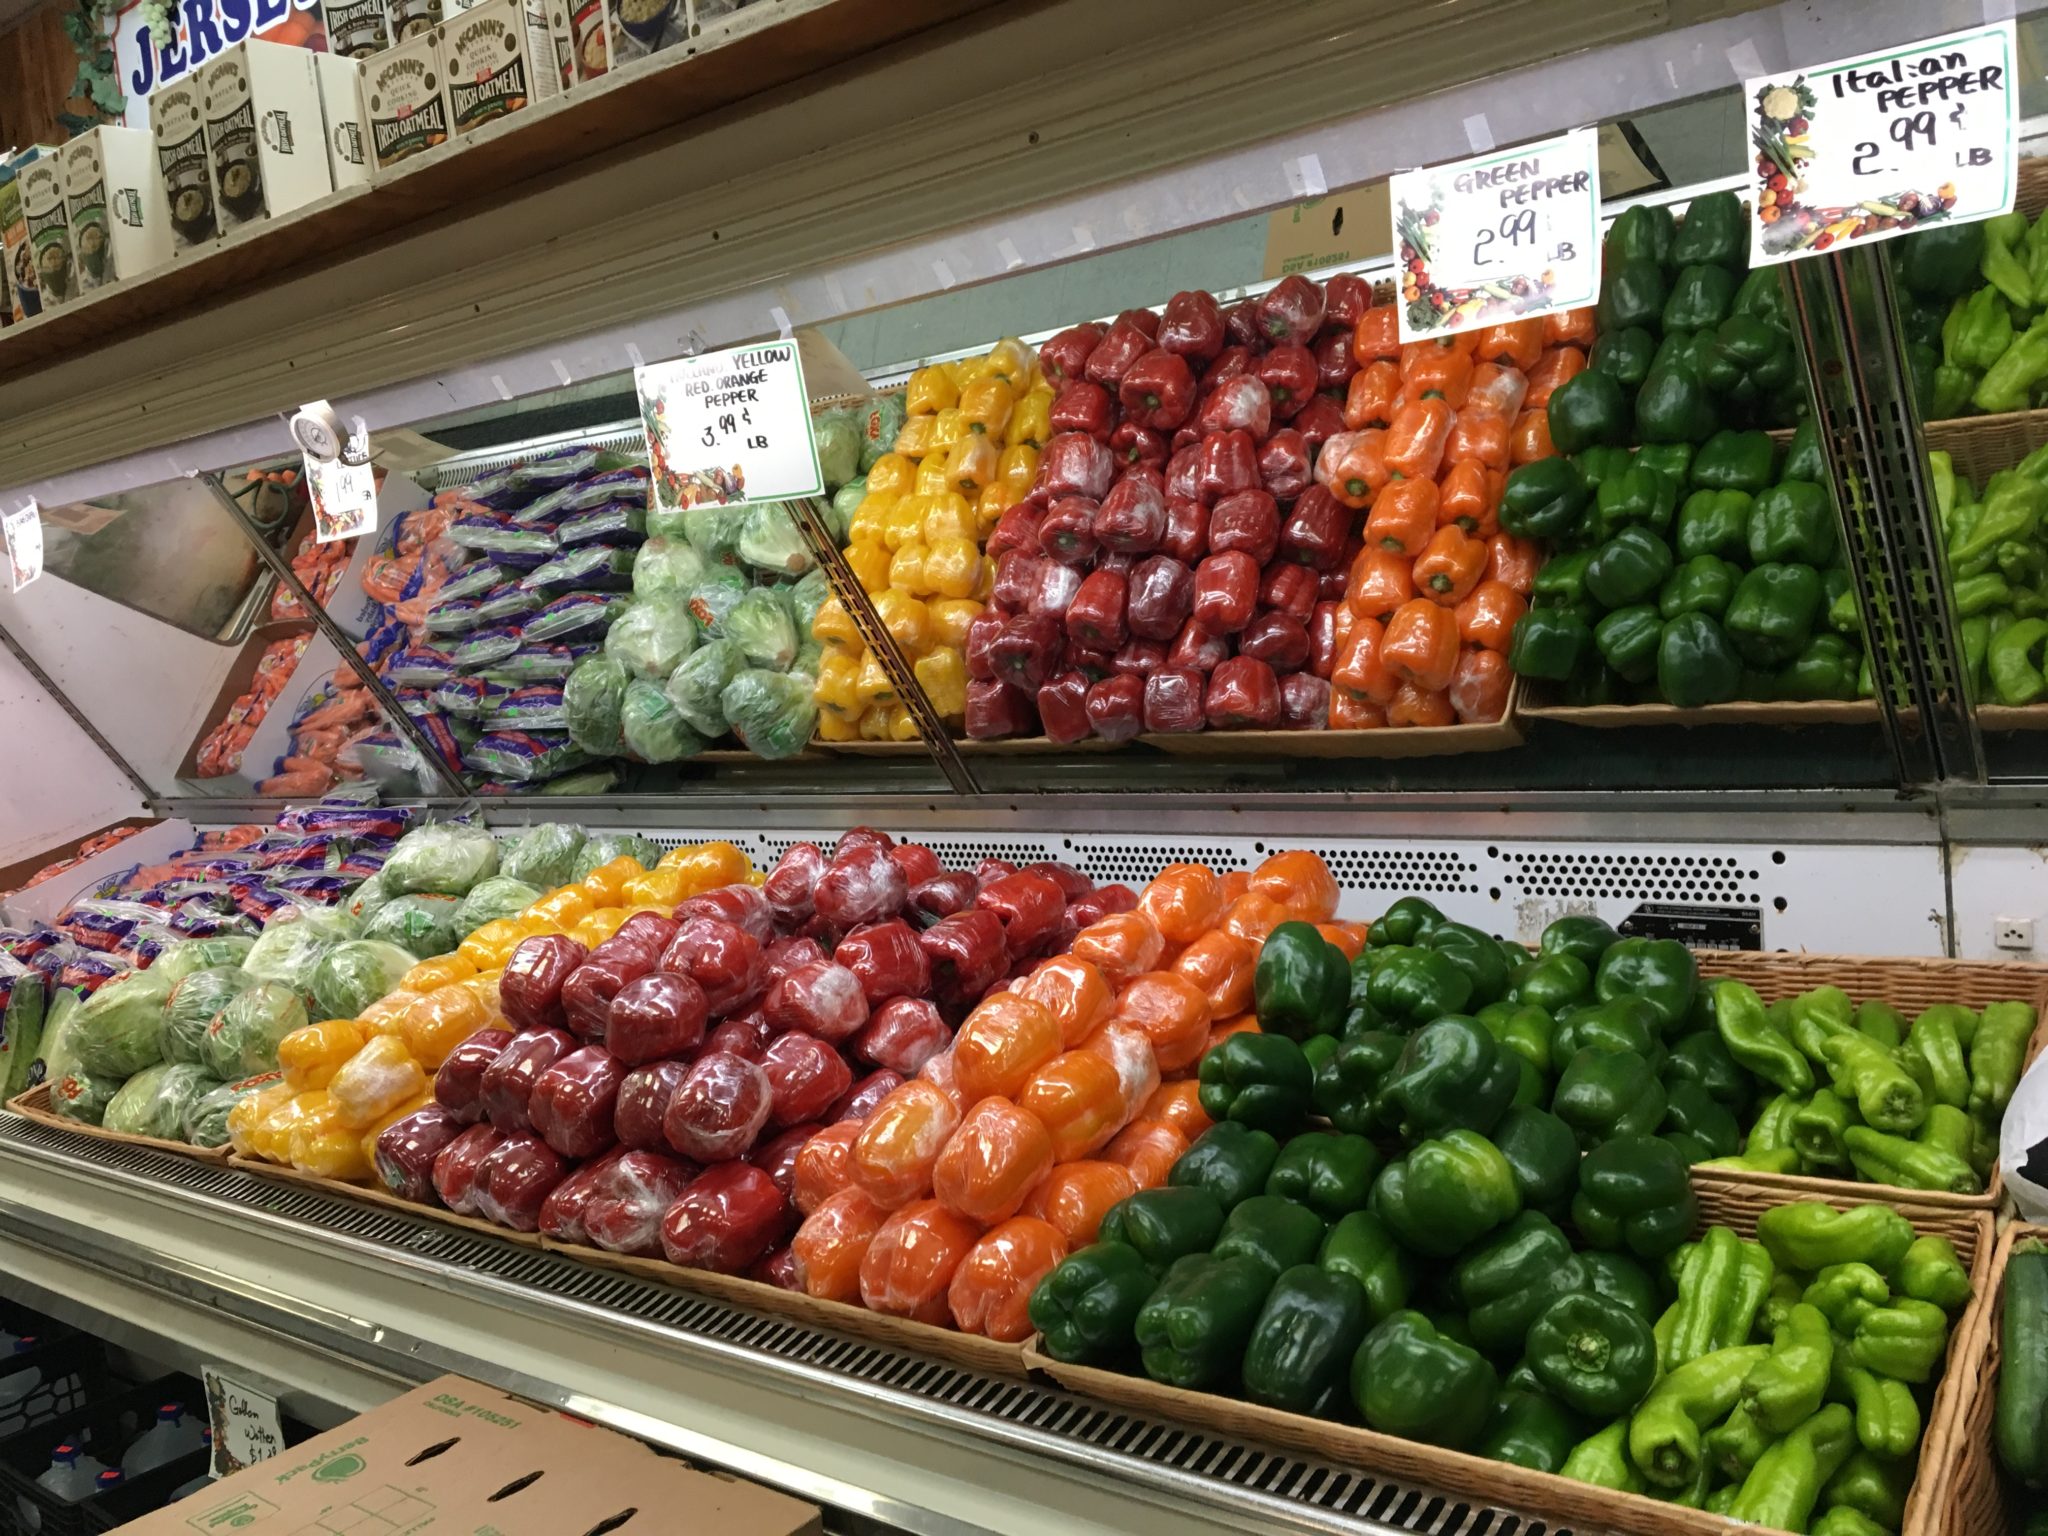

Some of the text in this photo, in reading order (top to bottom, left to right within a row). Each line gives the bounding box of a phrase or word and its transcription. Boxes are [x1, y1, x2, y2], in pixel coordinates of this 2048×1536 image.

[329, 9, 349, 32] IRISH
[348, 0, 384, 20] OATMEAL
[478, 63, 524, 101] OATMEAL
[1832, 52, 1967, 98] Italian
[1876, 66, 2004, 113] PEPPER
[223, 104, 254, 134] OATMEAL
[399, 101, 444, 137] OATMEAL
[453, 88, 477, 119] IRISH
[375, 122, 399, 153] IRISH
[1955, 147, 1993, 168] LB
[1453, 158, 1540, 194] GREEN
[1499, 170, 1590, 209] PEPPER
[732, 346, 791, 370] YELLOW
[716, 368, 768, 390] ORANGE
[704, 388, 759, 409] PEPPER
[747, 435, 769, 449] LB
